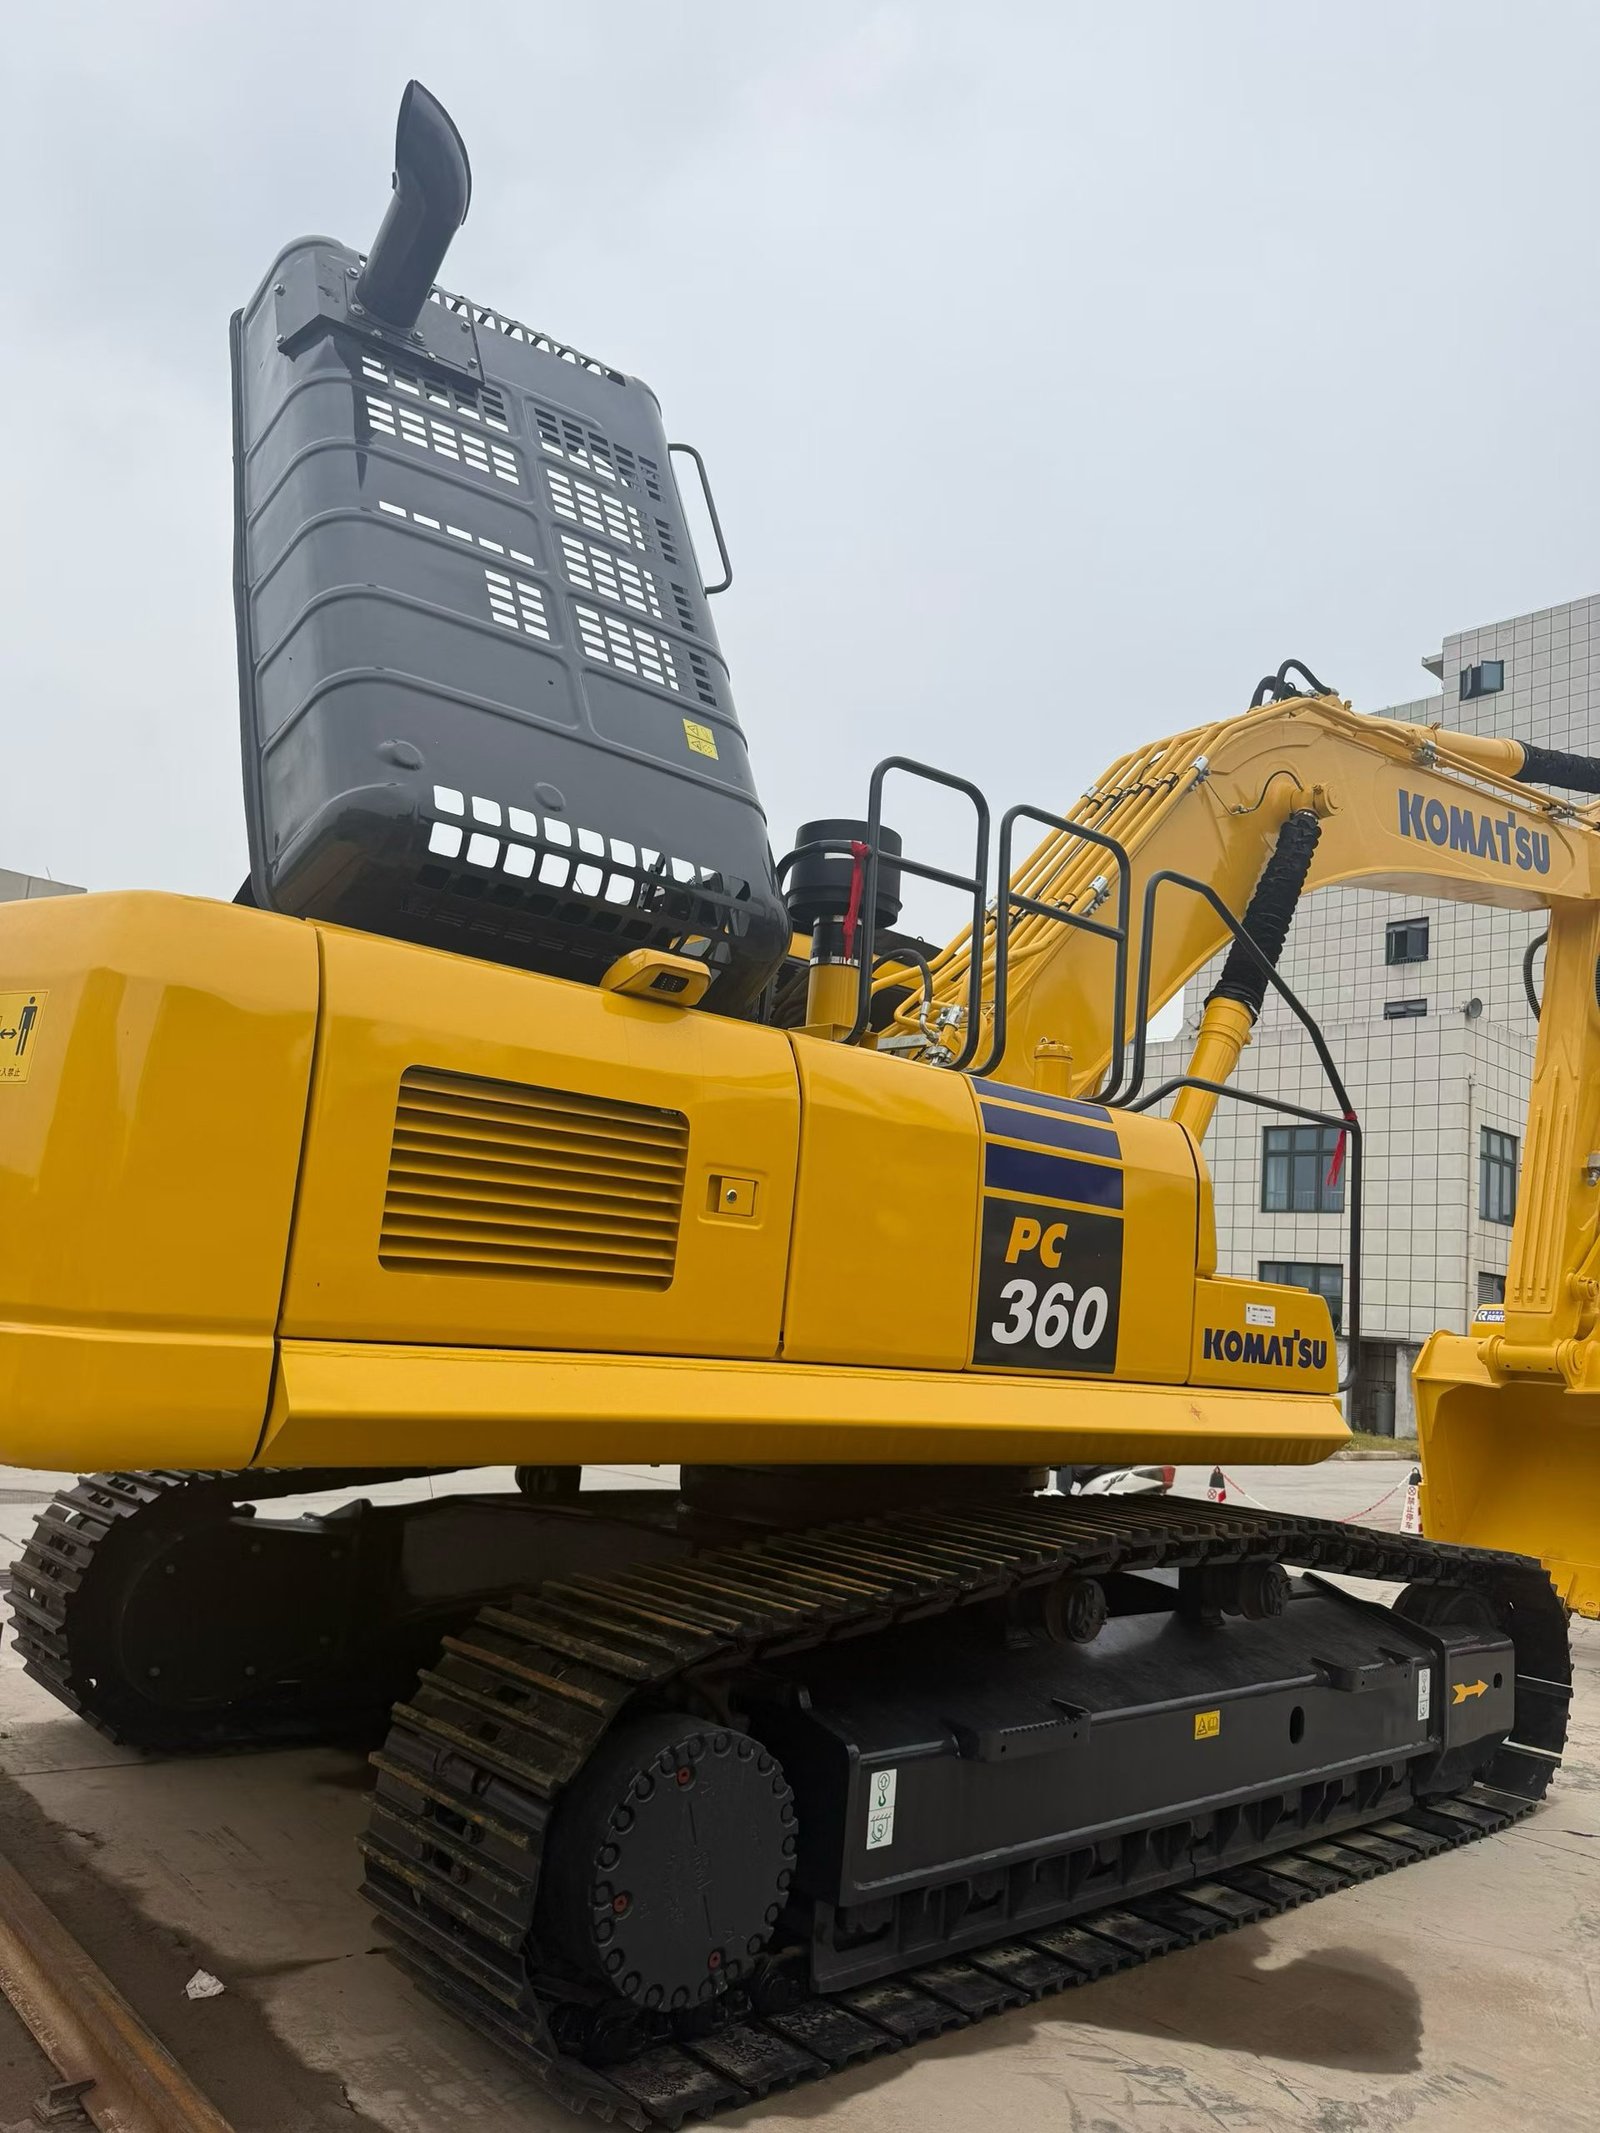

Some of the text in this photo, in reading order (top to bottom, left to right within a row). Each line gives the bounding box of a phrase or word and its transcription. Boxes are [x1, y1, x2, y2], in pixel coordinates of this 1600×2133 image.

[1399, 788, 1550, 875] KOMATSU
[1004, 1216, 1069, 1269] PC
[991, 1278, 1109, 1350] 360
[1203, 1327, 1328, 1370] KOMATSU
